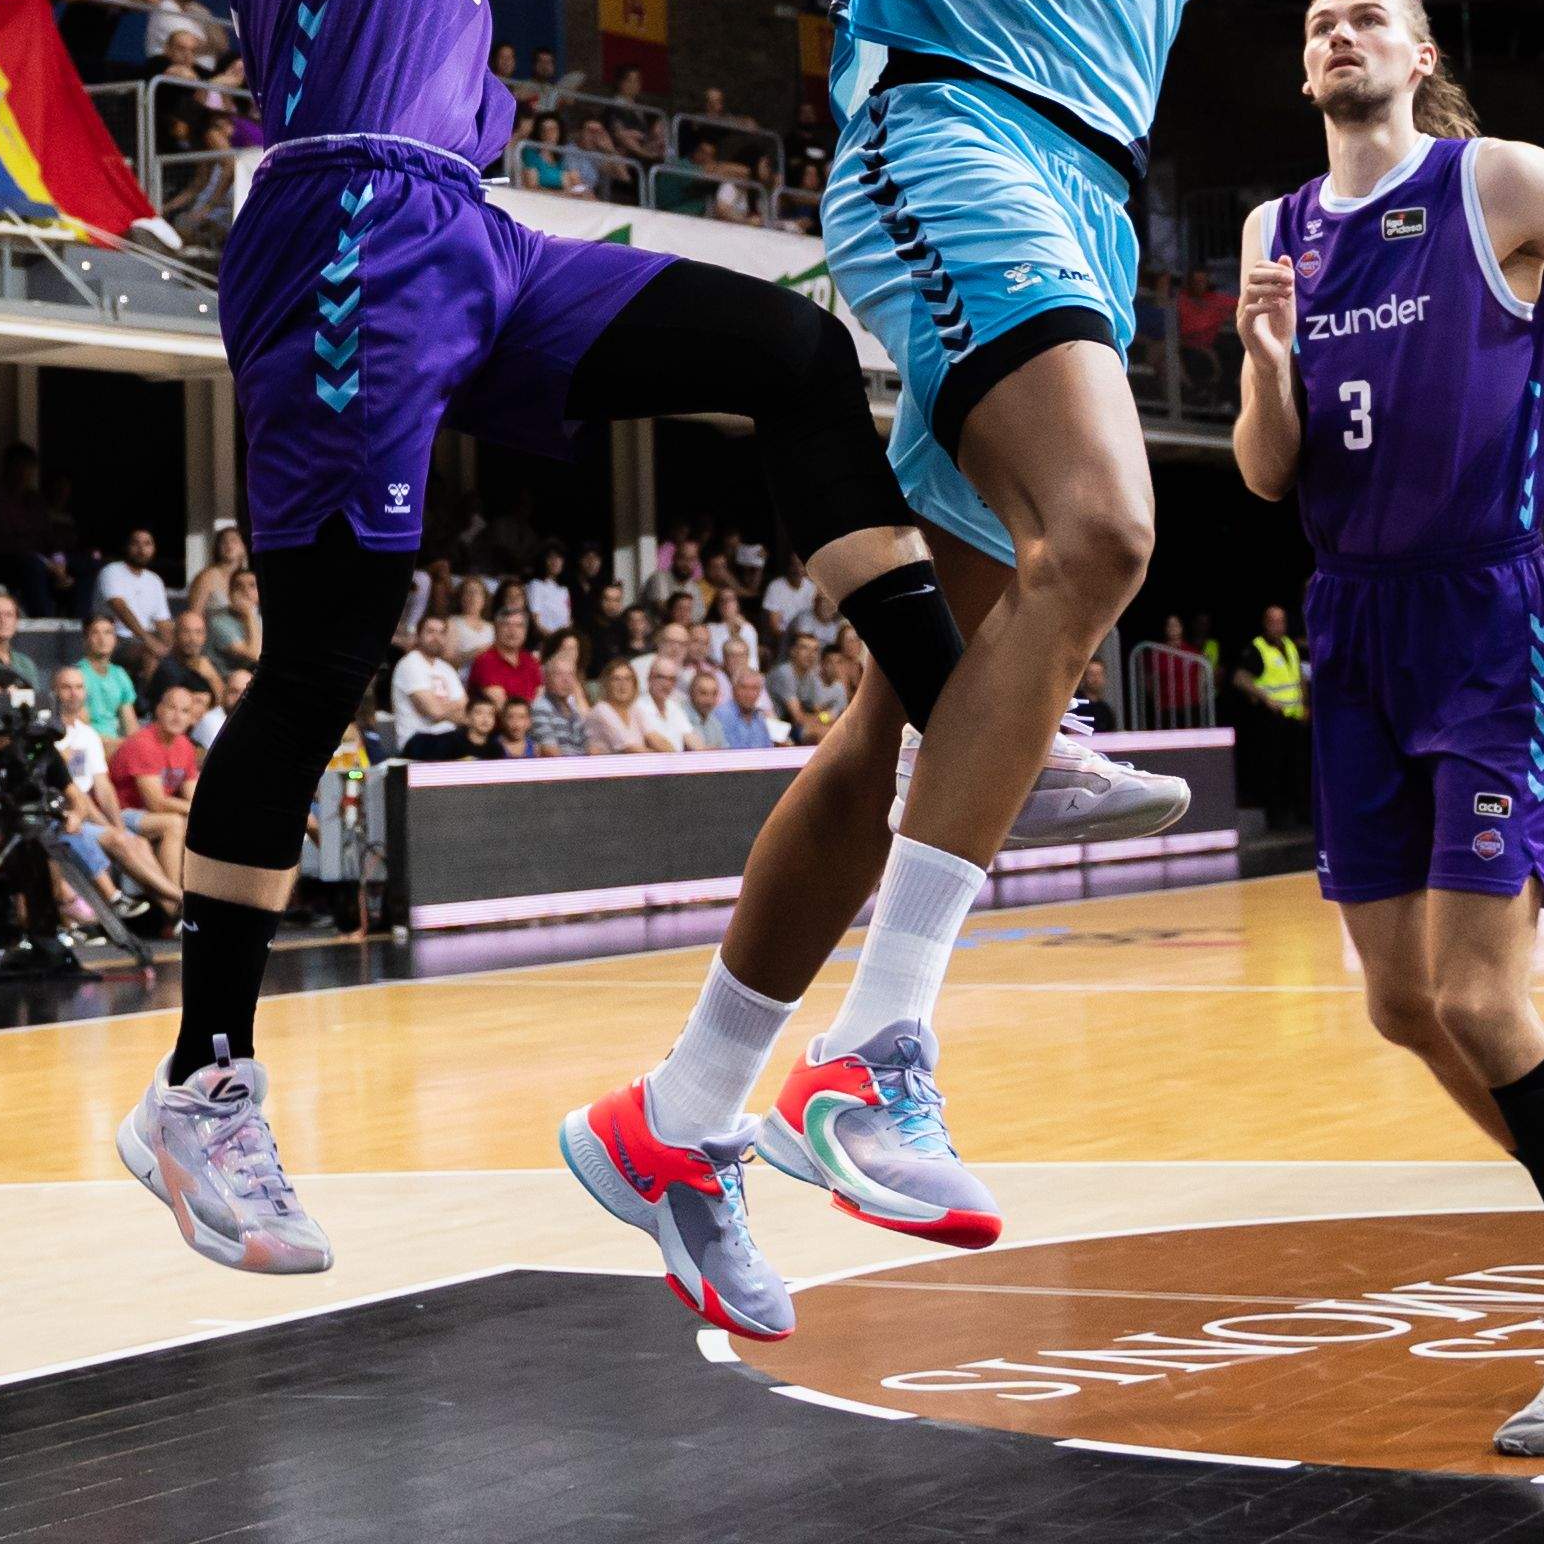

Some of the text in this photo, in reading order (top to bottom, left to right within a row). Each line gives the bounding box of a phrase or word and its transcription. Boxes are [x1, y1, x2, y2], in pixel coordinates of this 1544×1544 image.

[1306, 294, 1431, 340] zunder
[1338, 379, 1373, 451] 3
[1478, 802, 1503, 813] acb
